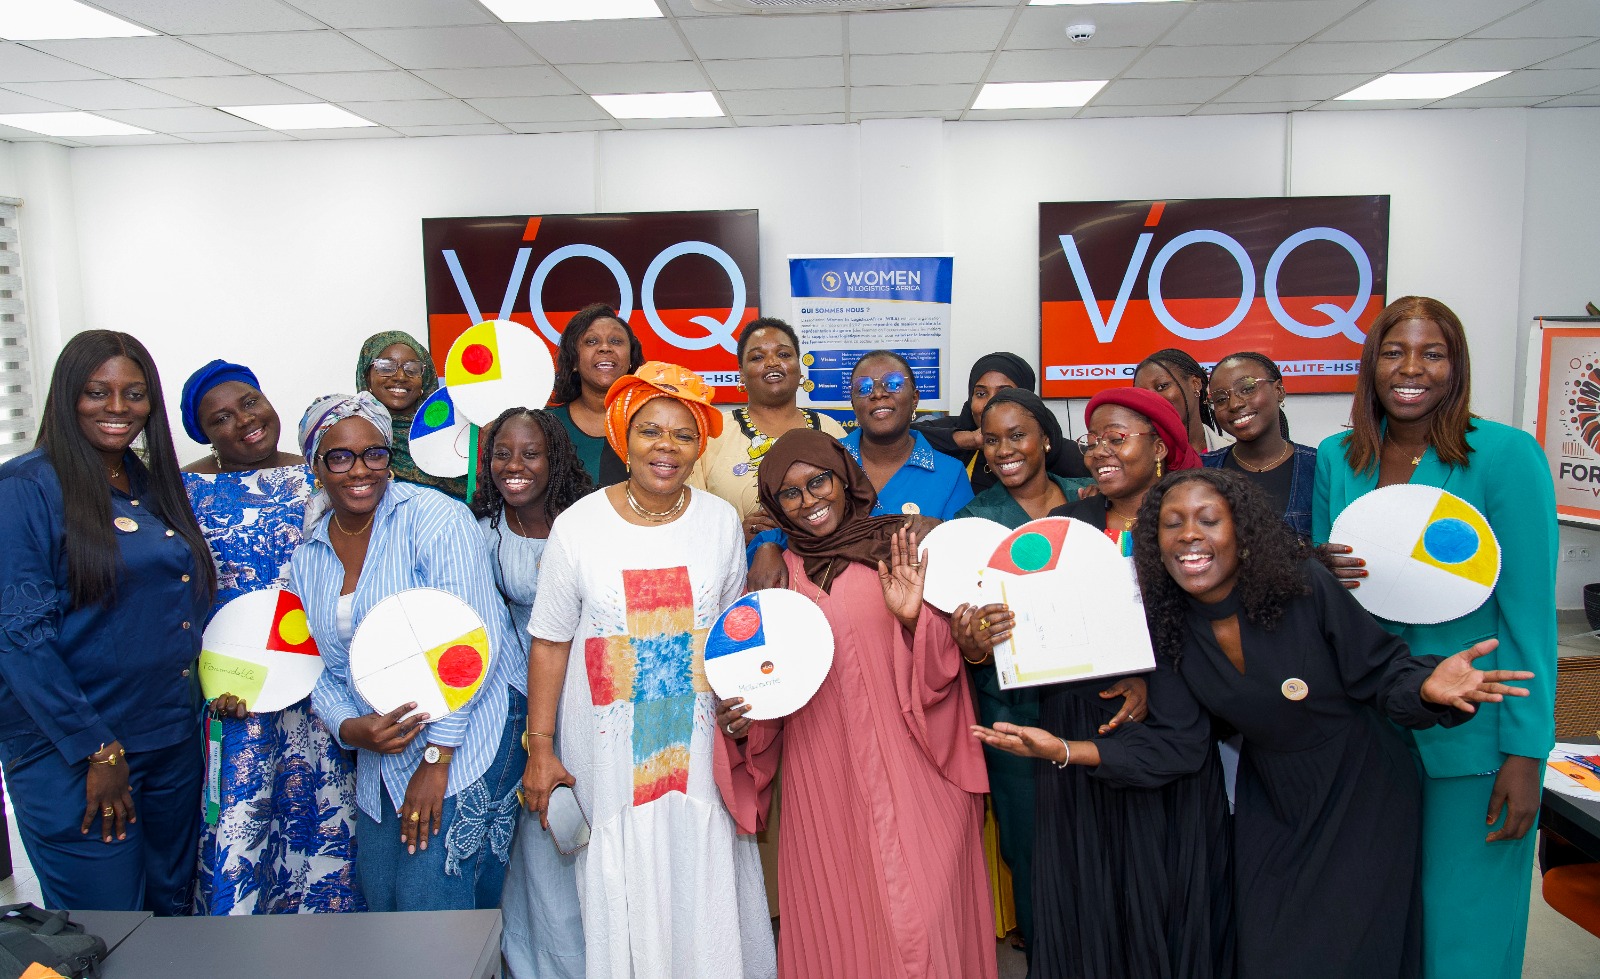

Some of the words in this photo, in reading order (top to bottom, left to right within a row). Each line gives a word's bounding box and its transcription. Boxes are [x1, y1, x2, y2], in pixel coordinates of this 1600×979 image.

[843, 270, 921, 286] WOMEN
[1058, 226, 1373, 345] VOQ
[1059, 366, 1116, 377] VISION
